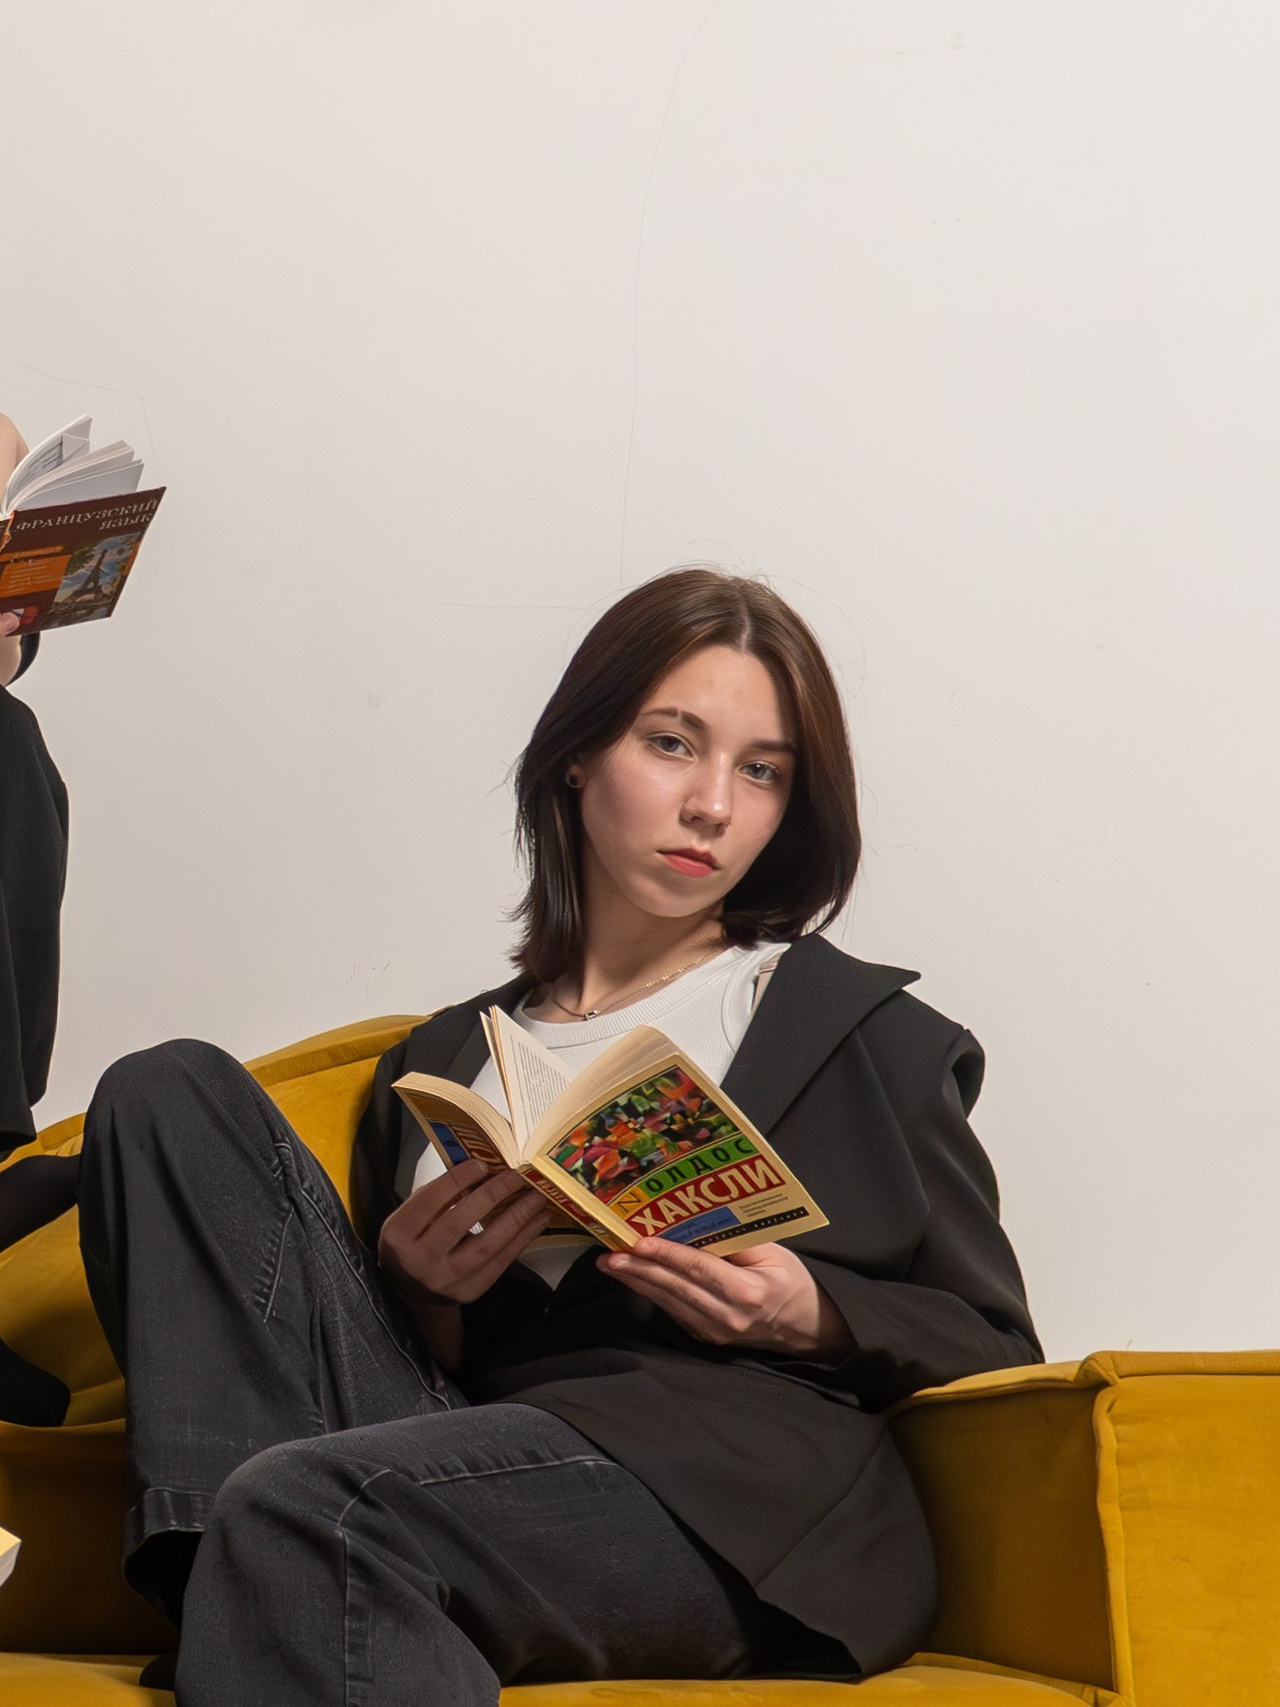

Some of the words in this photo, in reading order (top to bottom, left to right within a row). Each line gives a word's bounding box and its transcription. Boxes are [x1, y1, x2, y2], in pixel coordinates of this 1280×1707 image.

[17, 499, 158, 531] ФРАНЦУЗСКИЙ
[99, 512, 154, 530] ЯЗЫК
[645, 1138, 753, 1193] ОЛДОС
[631, 1158, 781, 1237] ХАКСЛИ
